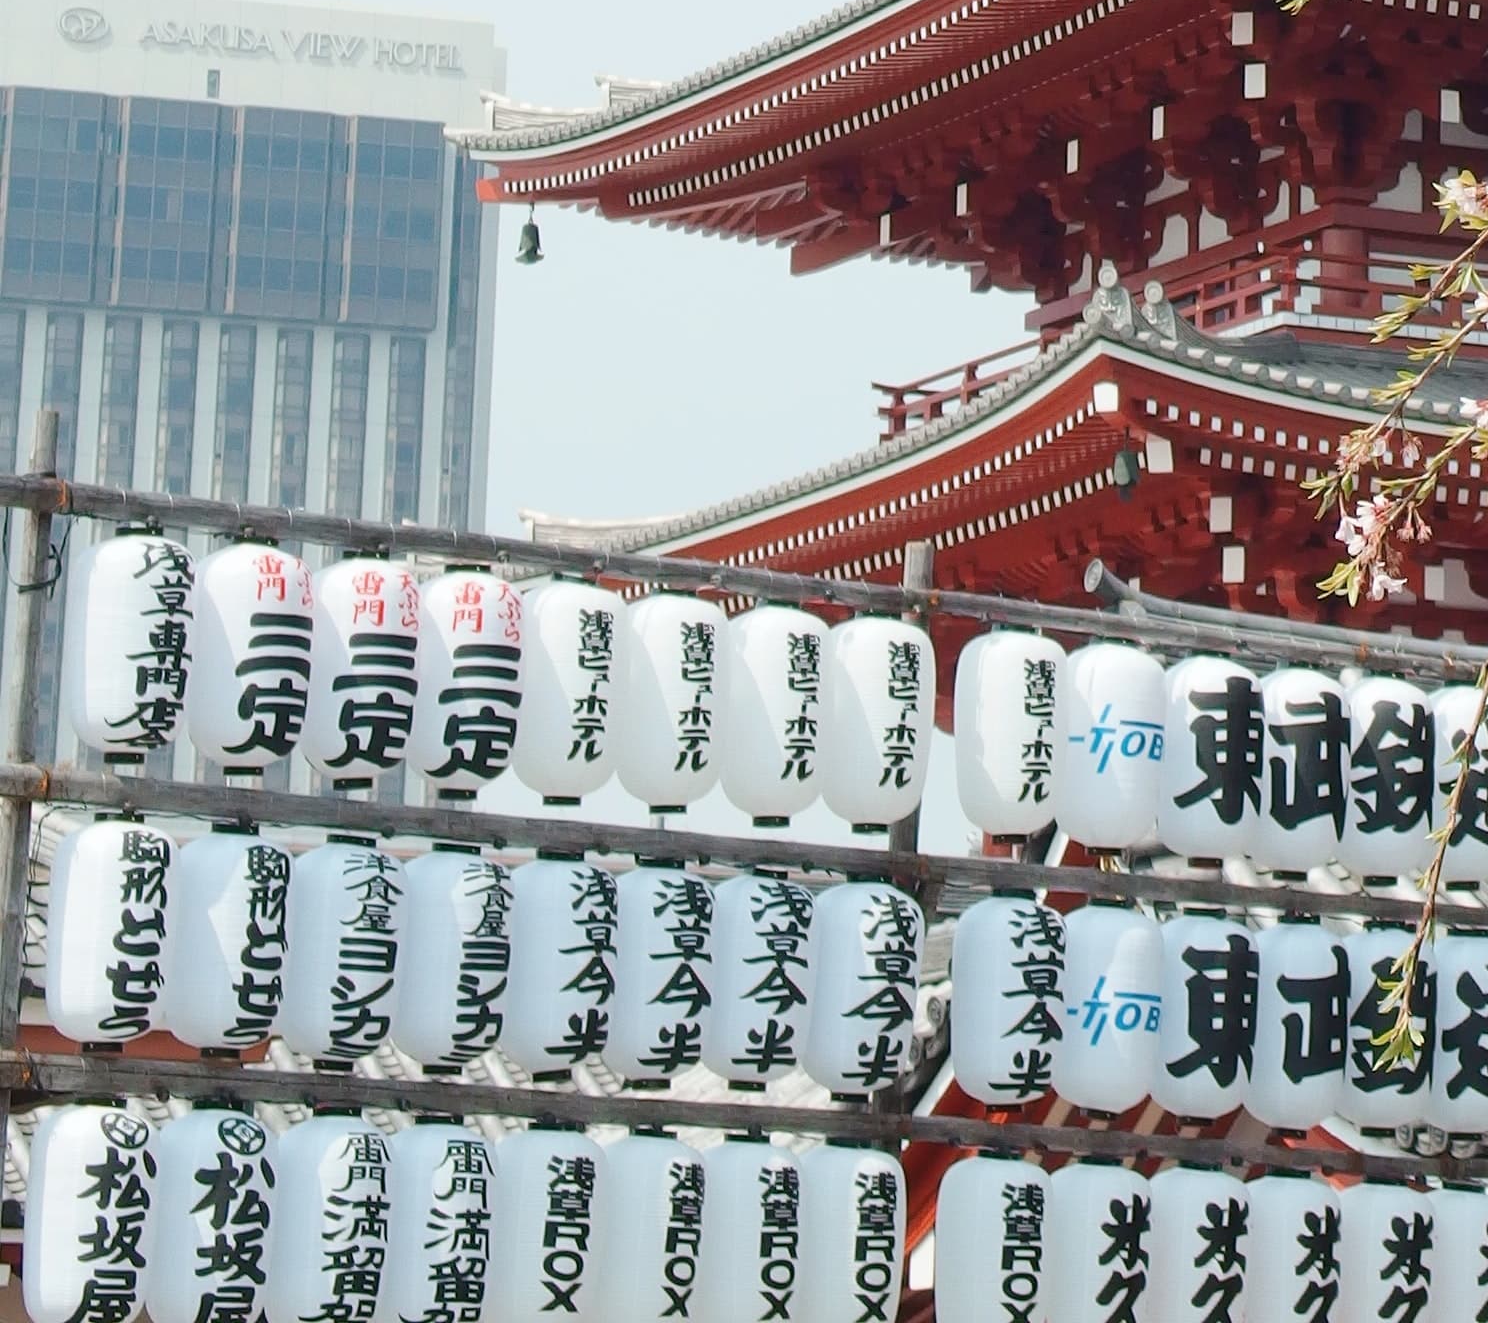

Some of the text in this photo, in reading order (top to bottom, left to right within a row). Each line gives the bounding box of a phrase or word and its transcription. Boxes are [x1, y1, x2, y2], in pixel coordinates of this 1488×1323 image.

[140, 20, 463, 71] ASAKUSA VIEW HOTEL
[252, 554, 288, 602] 雷門
[351, 570, 386, 628] 雷門
[452, 581, 486, 634] 雷門
[223, 612, 314, 756] 三定
[323, 633, 419, 769] 三定
[424, 644, 522, 780] 三定
[567, 608, 614, 763] 浅草ビューホテル
[674, 621, 715, 772] 浅草ビューホテル
[780, 632, 821, 782] 浅草ビューホテル
[878, 641, 921, 790] 浅草ビューホテル
[1017, 658, 1056, 804] 浅草ビューホテル
[543, 867, 618, 1065] 浅草今半
[637, 877, 716, 1074] 浅草今半
[731, 882, 815, 1074] 浅草今半
[840, 893, 920, 1087] 浅草今半
[988, 906, 1067, 1098] 浅草今半
[64, 1147, 157, 1323] 松坂屋
[540, 1156, 596, 1314] 浅草ROX
[658, 1161, 704, 1318] 浅草ROX
[757, 1166, 799, 1322] 浅草ROX
[853, 1171, 898, 1323] 浅草ROX
[1000, 1182, 1045, 1323] 浅草ROX
